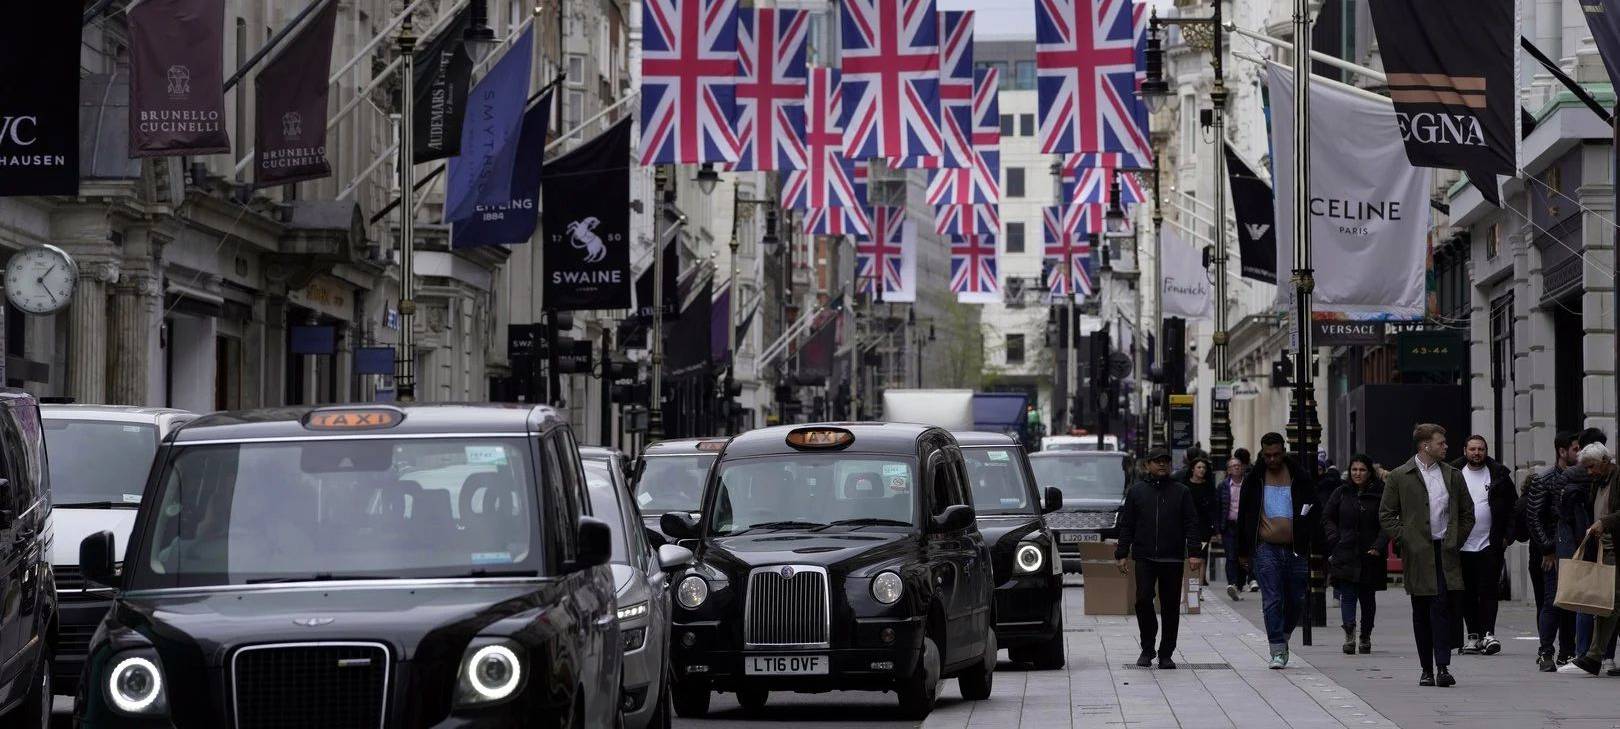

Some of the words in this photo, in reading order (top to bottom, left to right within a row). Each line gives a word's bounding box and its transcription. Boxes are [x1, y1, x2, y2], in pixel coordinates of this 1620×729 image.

[141, 111, 218, 120] BRUNELLO
[428, 89, 444, 150] AUDEMARS
[140, 122, 219, 132] CUCINELLI
[1310, 198, 1401, 221] CELINE
[483, 213, 504, 221] 1884
[1339, 227, 1368, 235] PARIS
[608, 233, 621, 241] 50
[552, 270, 621, 284] SWAINE
[1163, 277, 1207, 295] Fenwick
[1321, 325, 1376, 334] VERSACE
[319, 414, 385, 425] TAXI
[753, 658, 786, 672] LT16
[790, 657, 819, 671] OVF
